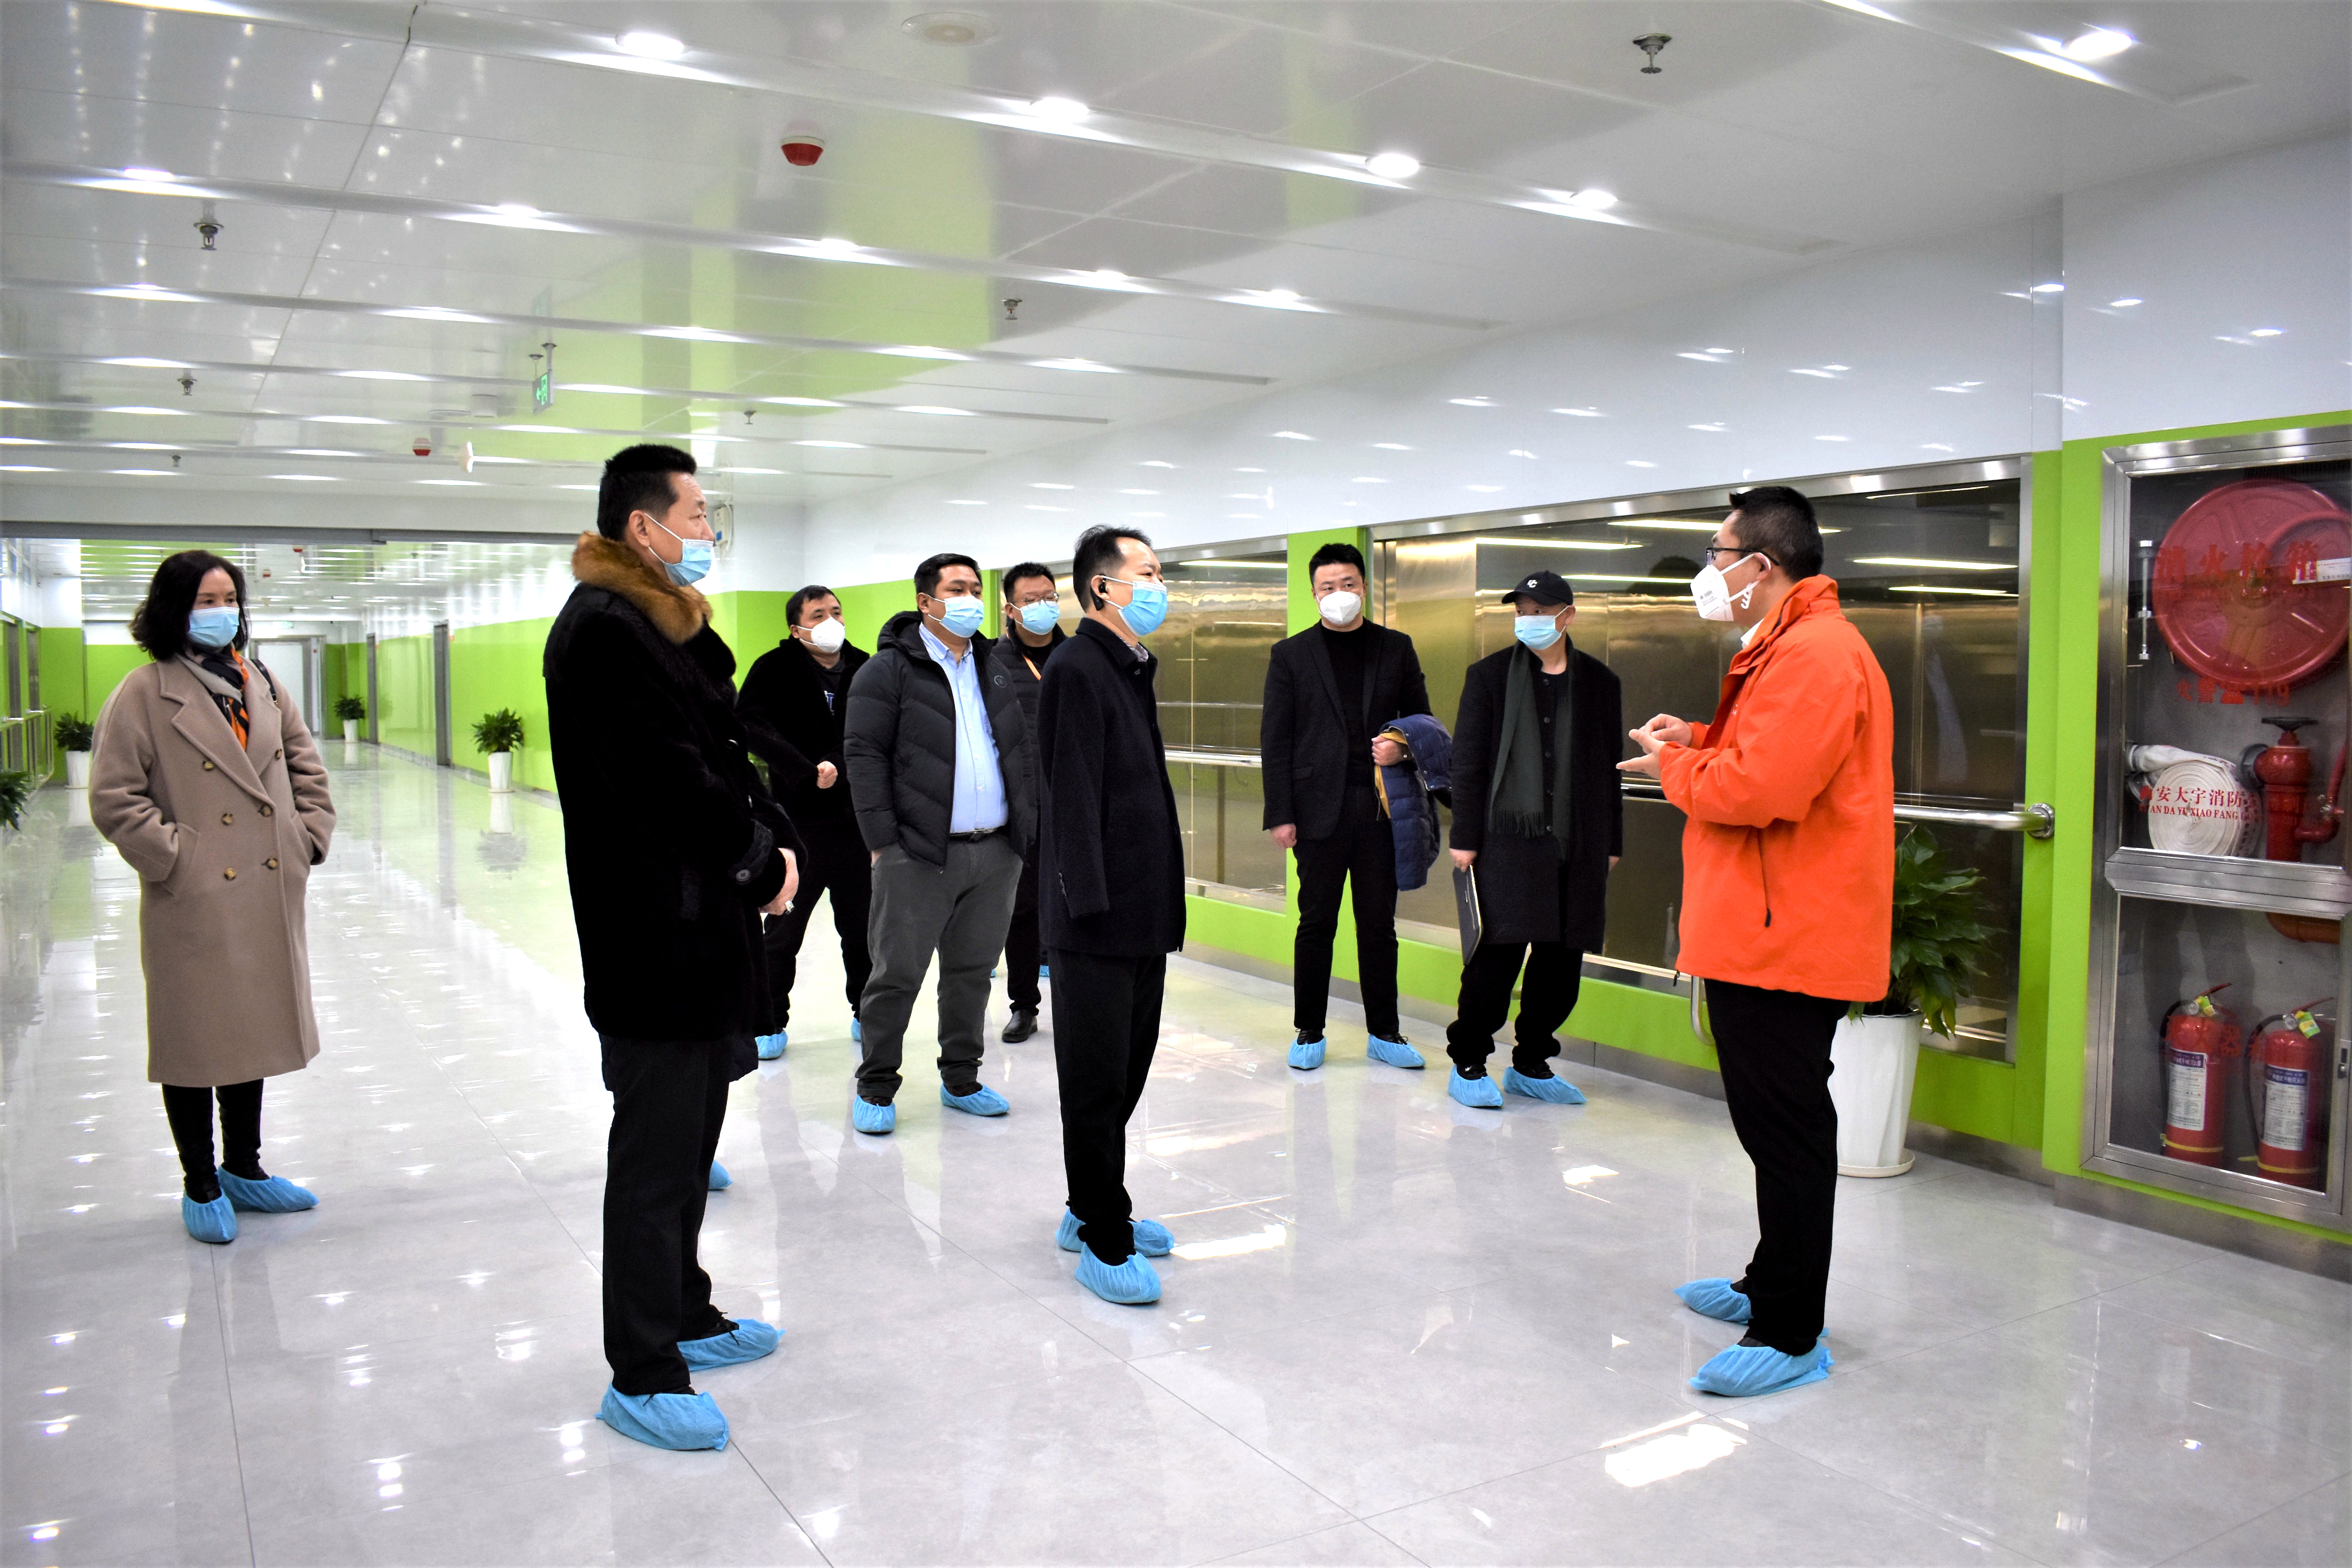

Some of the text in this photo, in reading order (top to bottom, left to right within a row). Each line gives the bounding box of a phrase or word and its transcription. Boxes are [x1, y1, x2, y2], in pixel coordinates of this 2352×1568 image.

[2164, 806, 2175, 815] DA
[2190, 808, 2212, 818] XIAO
[2214, 810, 2238, 820] FANG
